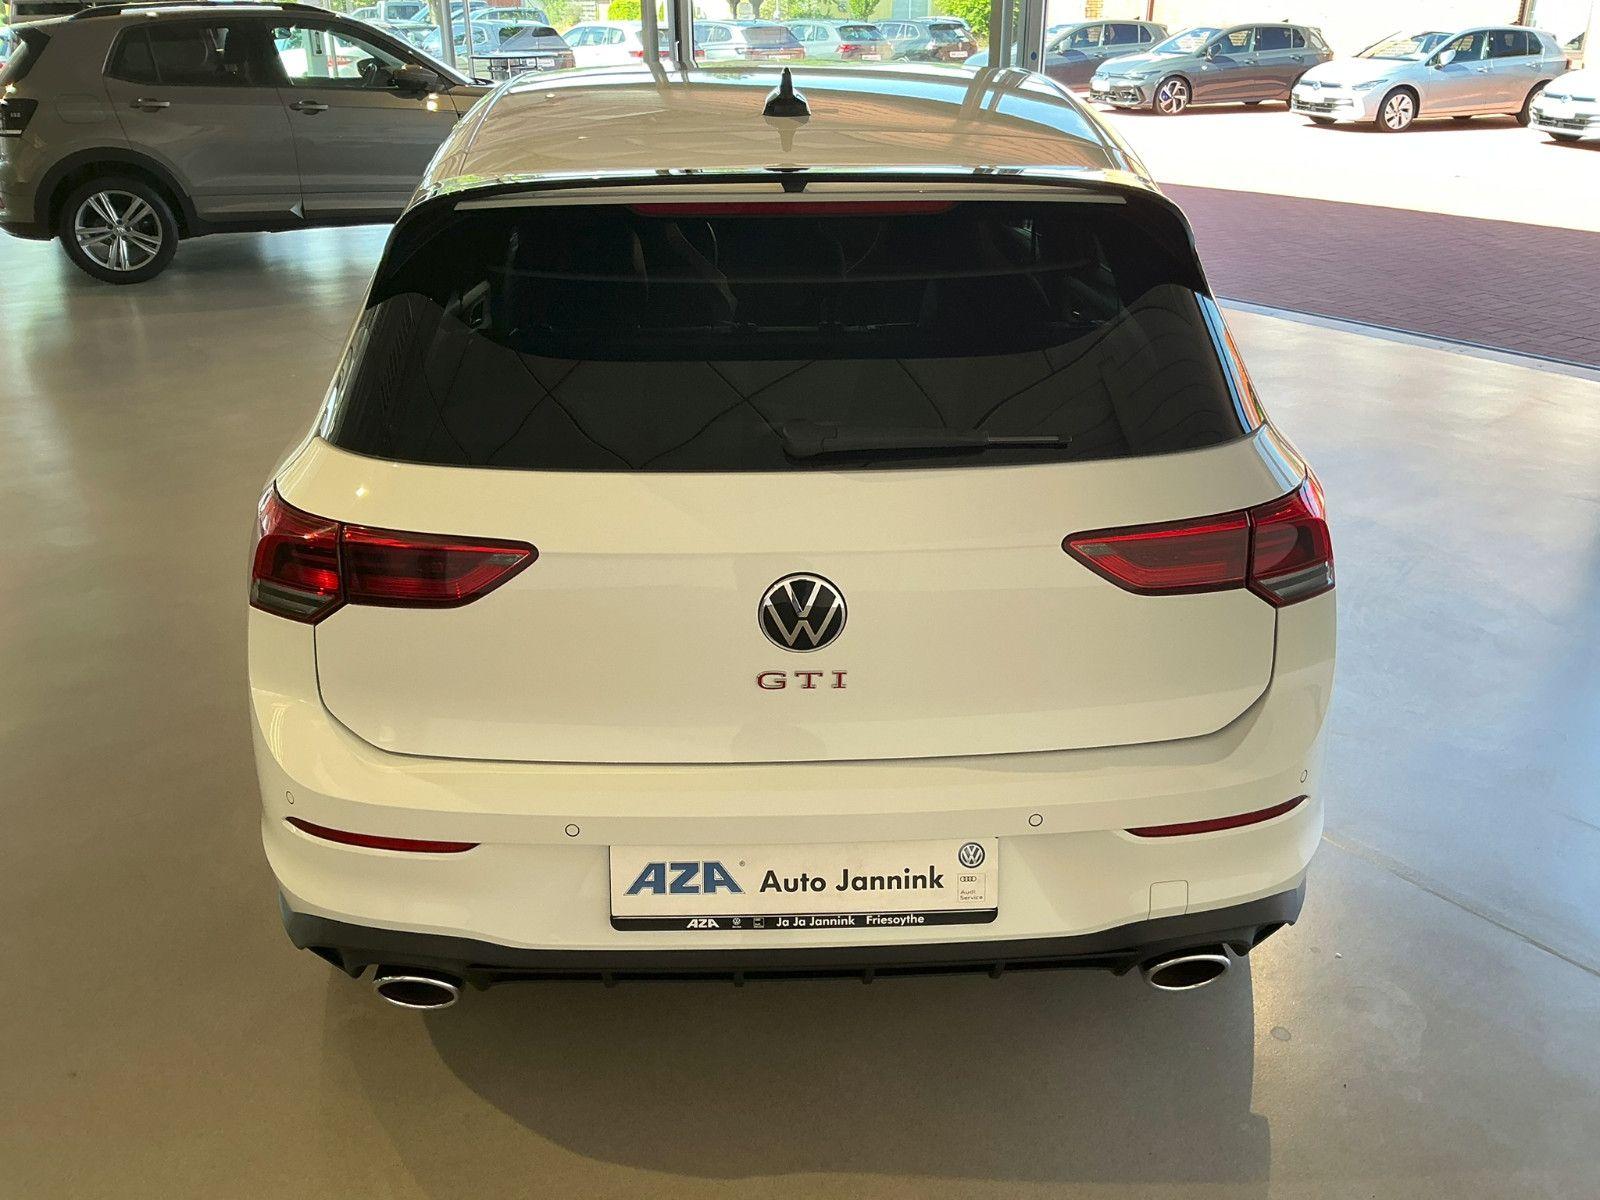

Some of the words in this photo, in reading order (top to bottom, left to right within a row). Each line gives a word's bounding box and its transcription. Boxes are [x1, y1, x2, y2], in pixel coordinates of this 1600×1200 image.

[757, 670, 847, 690] GTI
[623, 861, 745, 896] AZA
[759, 870, 827, 893] Auto
[835, 865, 944, 892] Jannink
[686, 918, 720, 929] AZA
[776, 917, 790, 927] Ja
[792, 917, 806, 927] Ja
[809, 915, 855, 926] Jannink
[866, 914, 925, 926] Friesoythe
